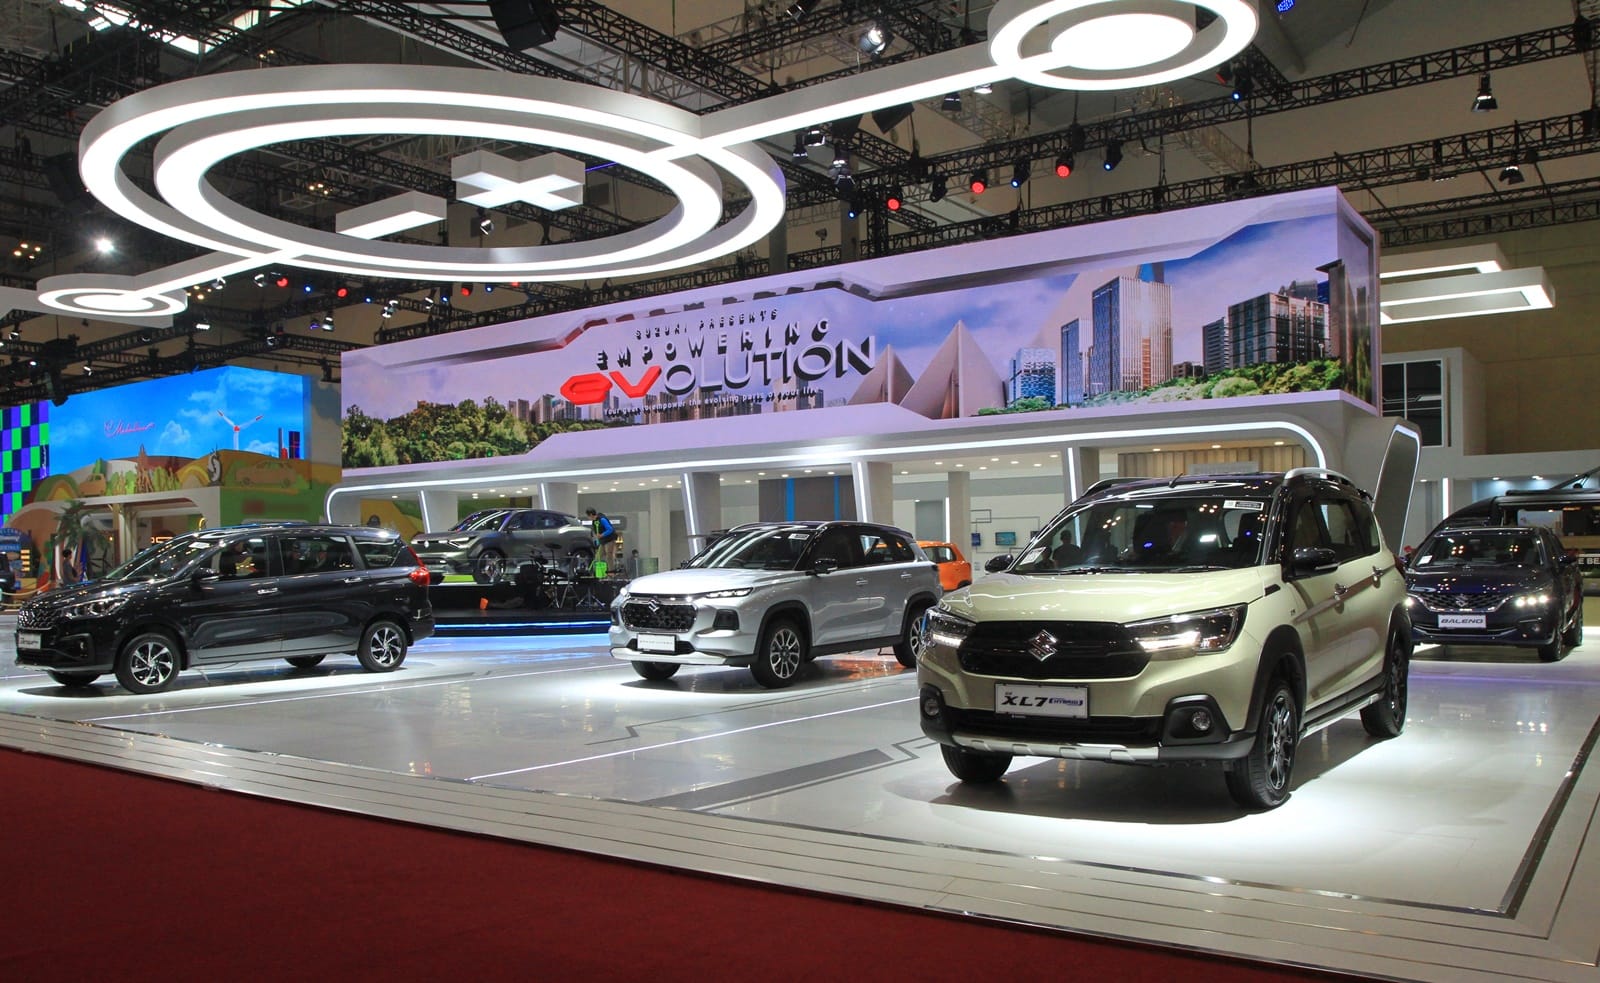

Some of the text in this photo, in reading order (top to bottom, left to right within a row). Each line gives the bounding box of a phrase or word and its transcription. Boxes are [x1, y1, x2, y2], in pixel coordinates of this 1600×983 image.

[635, 308, 778, 341] SUZUKI PRESENTS
[594, 317, 830, 371] EMPOWERING
[651, 400, 686, 412] empower
[1002, 696, 1048, 707] XL7
